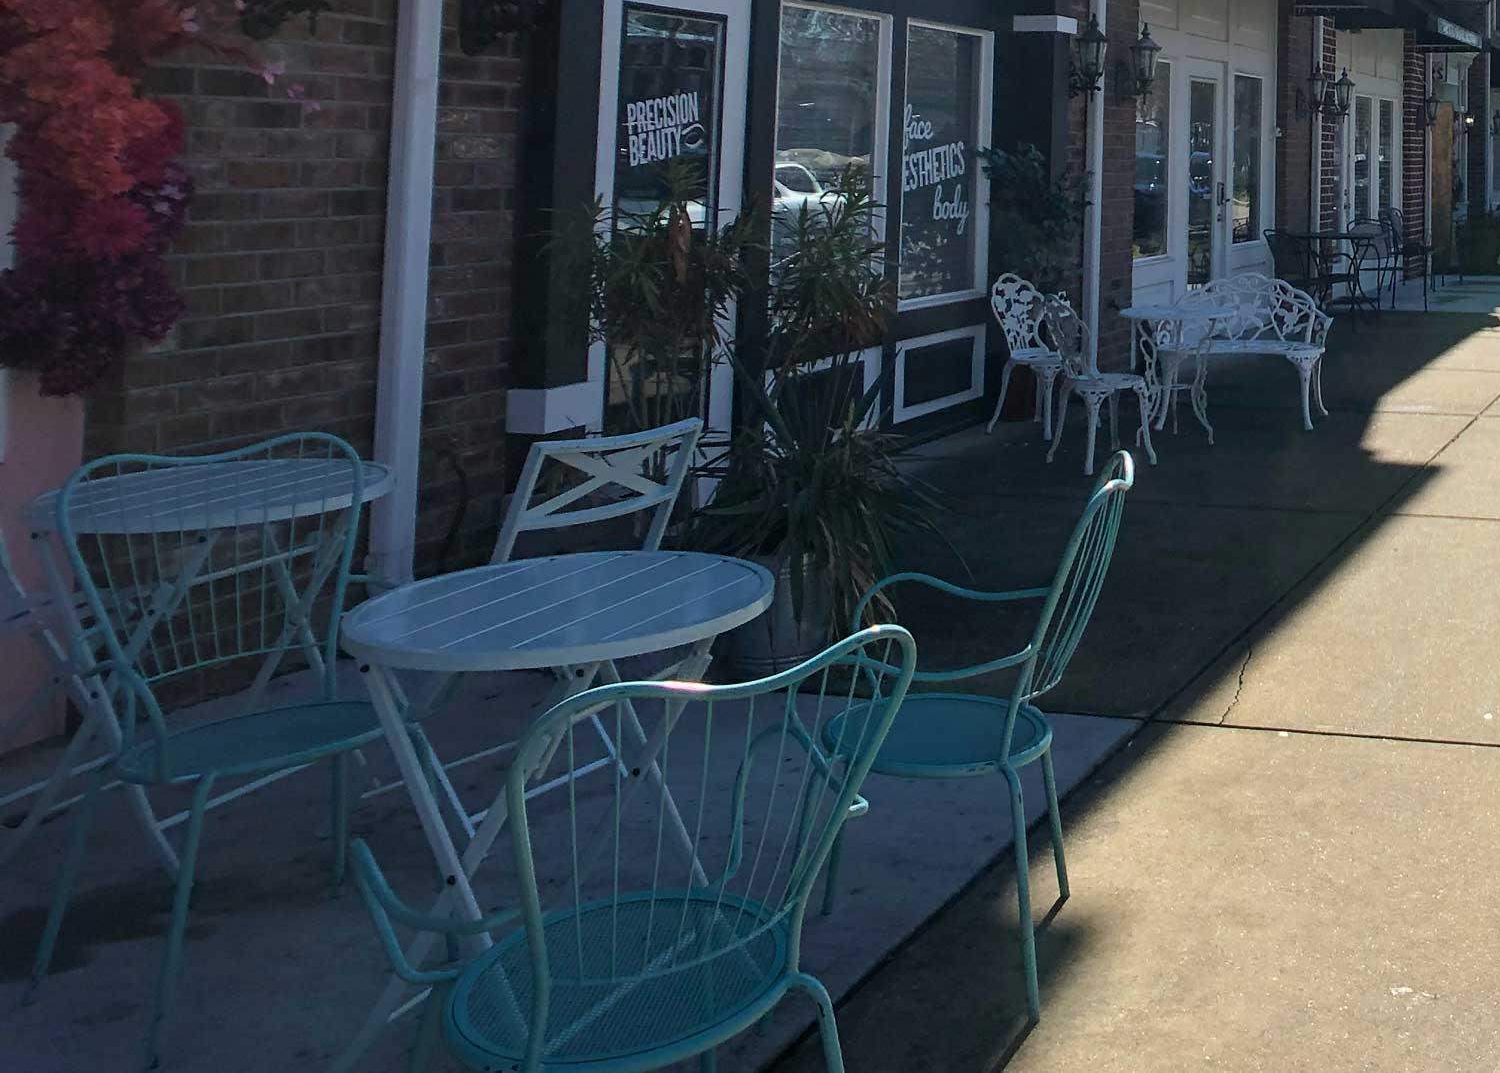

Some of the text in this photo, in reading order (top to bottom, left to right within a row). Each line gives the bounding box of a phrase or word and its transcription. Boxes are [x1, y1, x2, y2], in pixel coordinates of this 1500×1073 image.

[627, 91, 699, 135] PRECISION
[903, 103, 934, 150] face
[629, 125, 681, 167] BEAUTY
[903, 140, 966, 192] ESTHETICS
[933, 184, 970, 235] body
